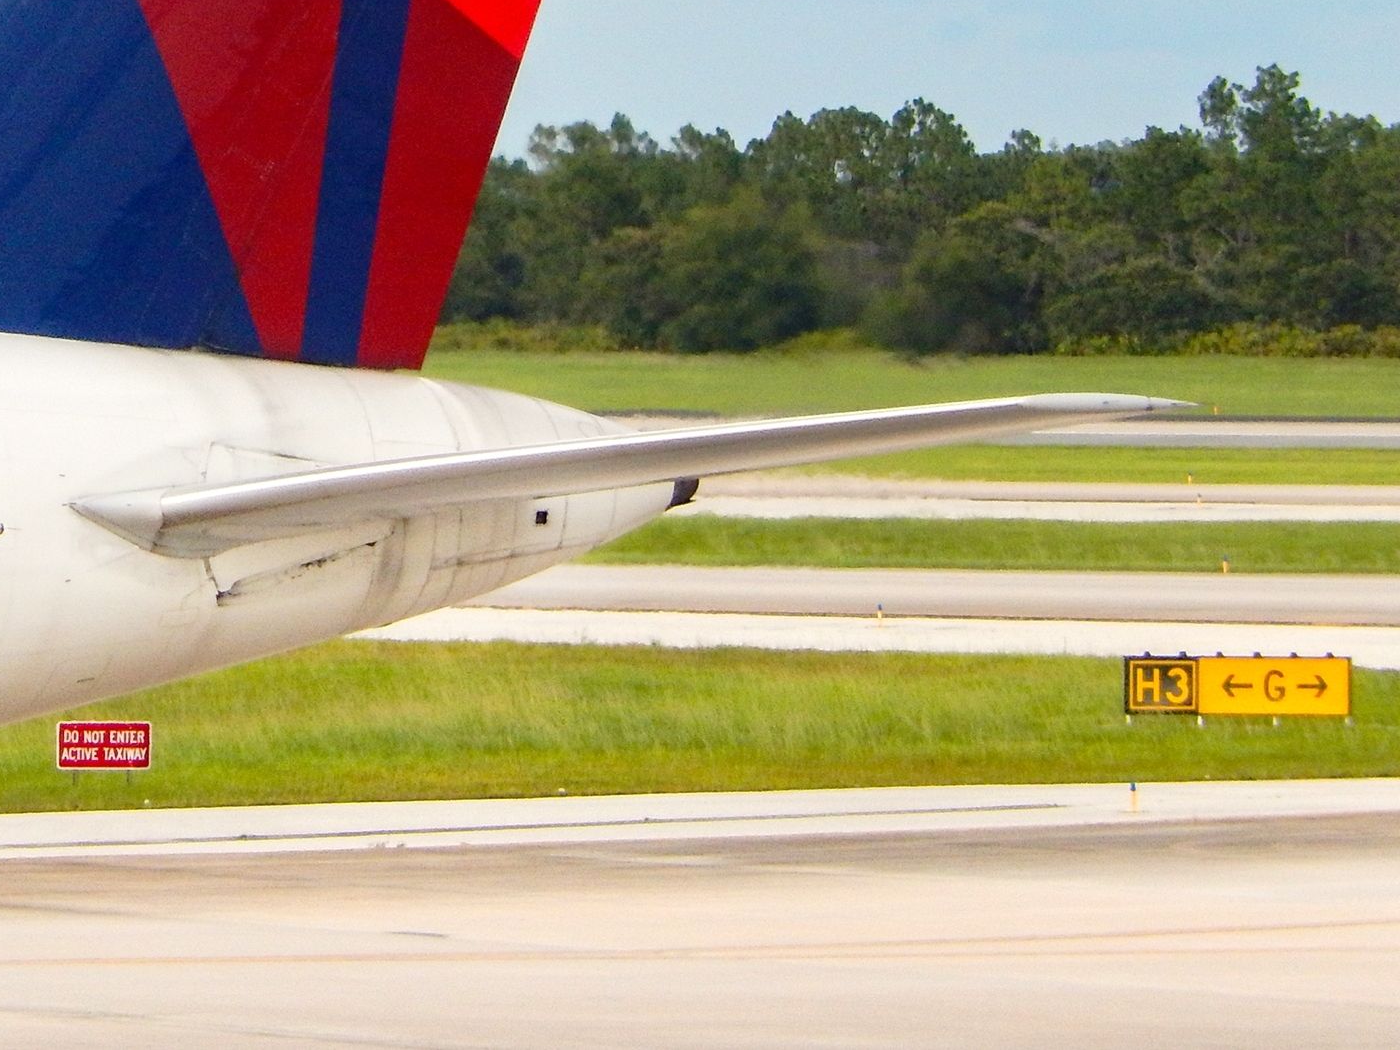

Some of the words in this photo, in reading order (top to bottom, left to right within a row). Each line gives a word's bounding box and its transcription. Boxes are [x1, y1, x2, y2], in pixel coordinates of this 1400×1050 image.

[1136, 667, 1189, 704] H3
[1264, 669, 1286, 702] G
[63, 730, 79, 744] DO
[83, 730, 106, 744] NOT
[109, 730, 145, 744] ENTER
[61, 747, 99, 761] ACTIVE
[103, 747, 147, 761] TAXIWAY
